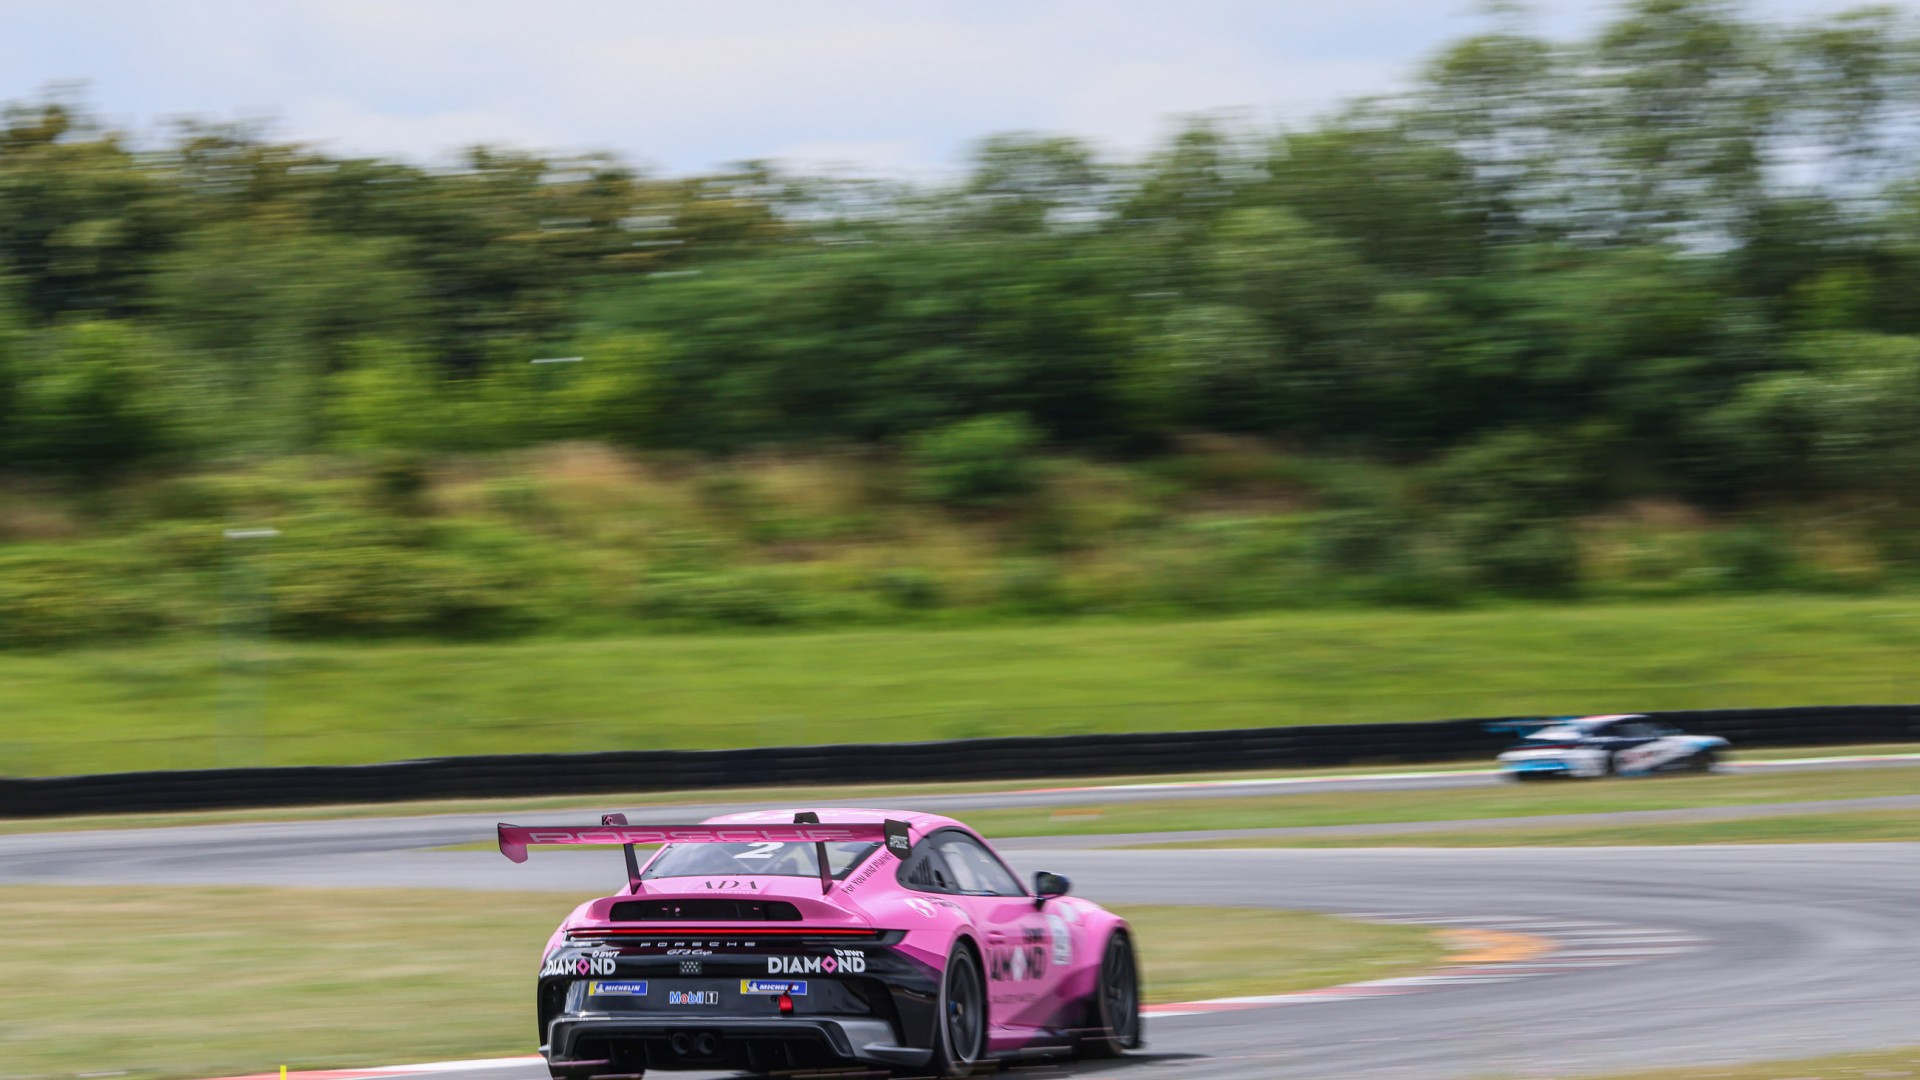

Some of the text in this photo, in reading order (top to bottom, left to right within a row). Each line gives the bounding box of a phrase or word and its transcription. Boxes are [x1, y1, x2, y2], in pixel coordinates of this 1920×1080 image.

[528, 829, 855, 843] PORSCHE
[733, 842, 785, 858] 2
[694, 880, 758, 890] ADA
[841, 884, 857, 895] For
[851, 874, 866, 886] You
[863, 865, 879, 878] and
[546, 958, 616, 976] DIAMOND
[767, 956, 866, 974] DIAMOND
[604, 984, 641, 992] MICHELIN
[669, 991, 705, 1004] Mobil
